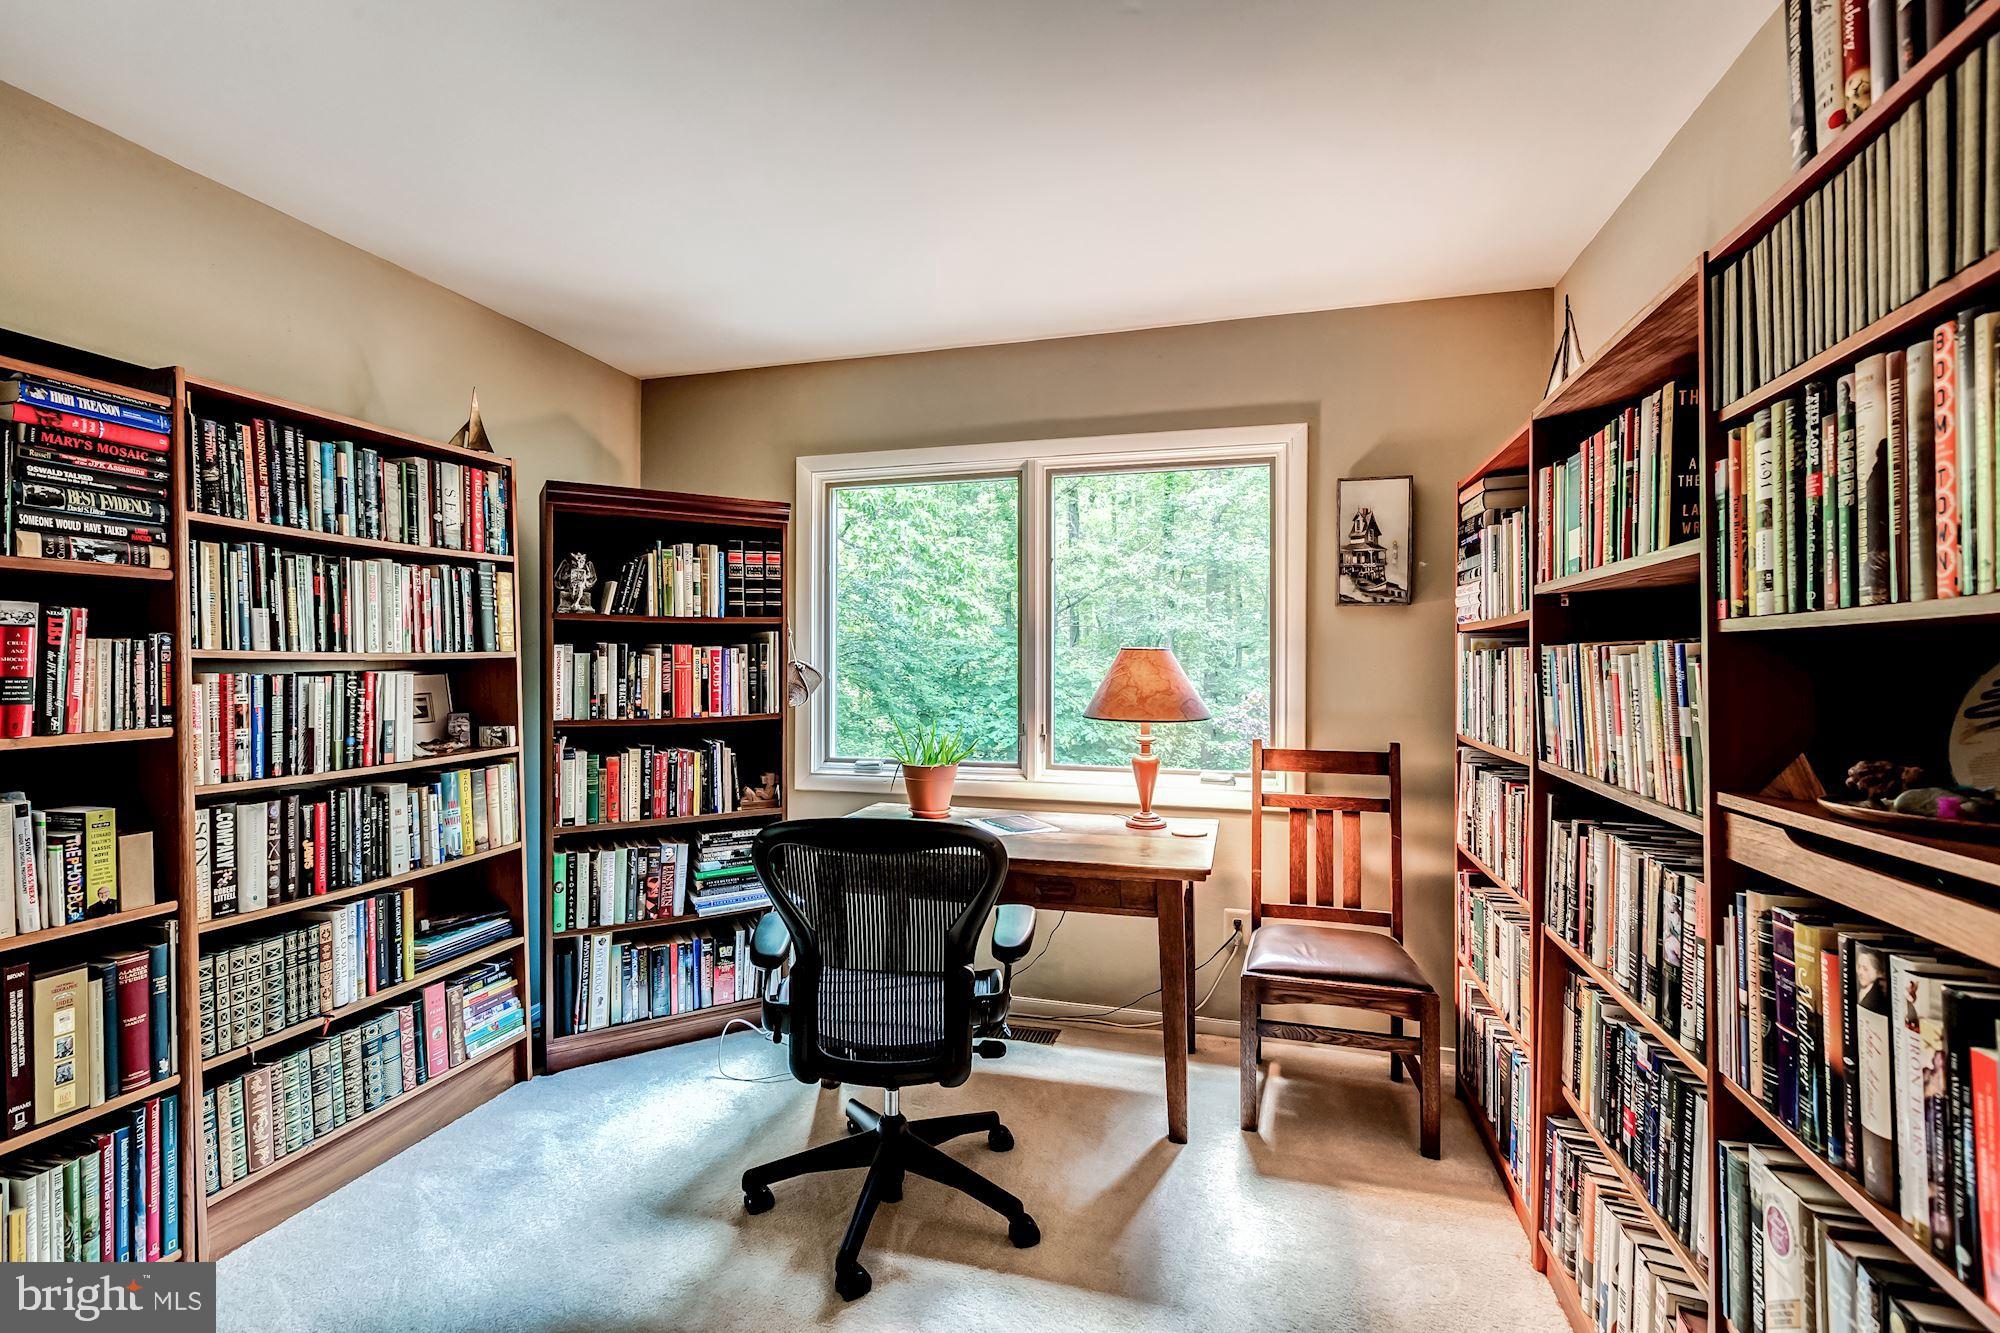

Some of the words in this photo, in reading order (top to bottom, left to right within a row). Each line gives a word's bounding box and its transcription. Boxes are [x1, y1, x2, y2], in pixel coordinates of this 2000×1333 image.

[1810, 392, 1820, 425] THE
[41, 431, 93, 451] MARY'S
[97, 443, 149, 462] MOSAIC
[1810, 426, 1819, 466] LOST
[27, 465, 63, 478] OSWALD
[1688, 458, 1697, 470] A
[1759, 447, 1773, 489] 1491
[1837, 429, 1854, 508] EMPIRE
[474, 479, 482, 497] RED
[444, 488, 457, 528] SEA
[18, 514, 54, 529] SOMEONE
[56, 518, 81, 531] WOULD
[83, 521, 102, 534] HAVE
[104, 524, 128, 537] TALKED
[1826, 519, 1834, 543] David
[1826, 544, 1834, 585] Grann
[216, 812, 235, 868] COMPANY
[363, 817, 371, 856] SORRY
[339, 912, 347, 934] DEUS
[340, 938, 347, 949] LO
[1681, 922, 1696, 1010] FREETHINKERS
[1820, 958, 1829, 992] SARAH
[1797, 967, 1816, 1091] Mayflower
